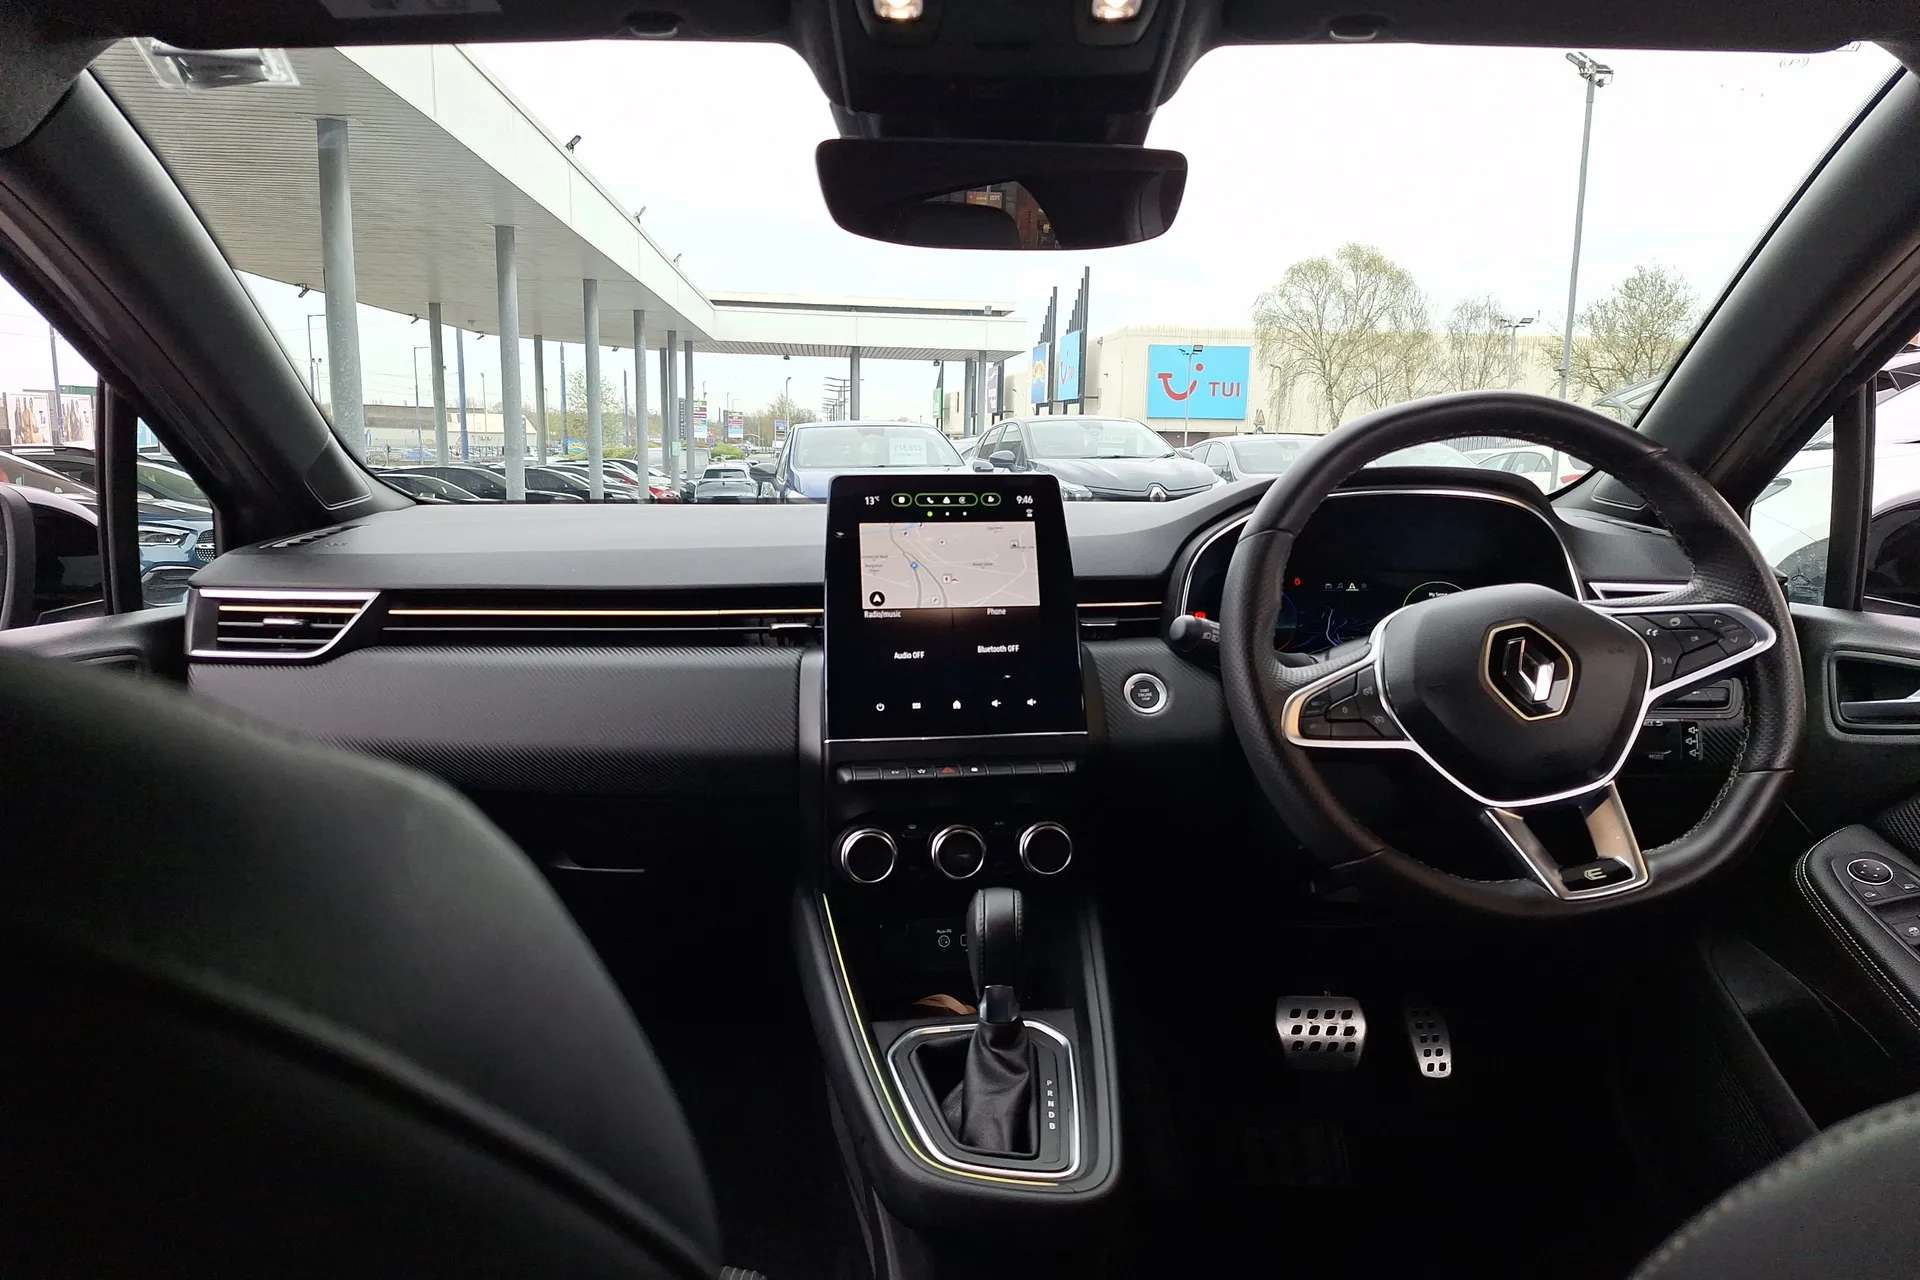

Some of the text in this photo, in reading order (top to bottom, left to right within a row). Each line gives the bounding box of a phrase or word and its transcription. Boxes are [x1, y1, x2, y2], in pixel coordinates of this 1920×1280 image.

[1208, 382, 1241, 397] TUI
[986, 608, 1006, 616] Phone
[977, 644, 1020, 654] Bluetooth OFF
[894, 650, 925, 660] Audio OFF
[1047, 1089, 1054, 1097] R
